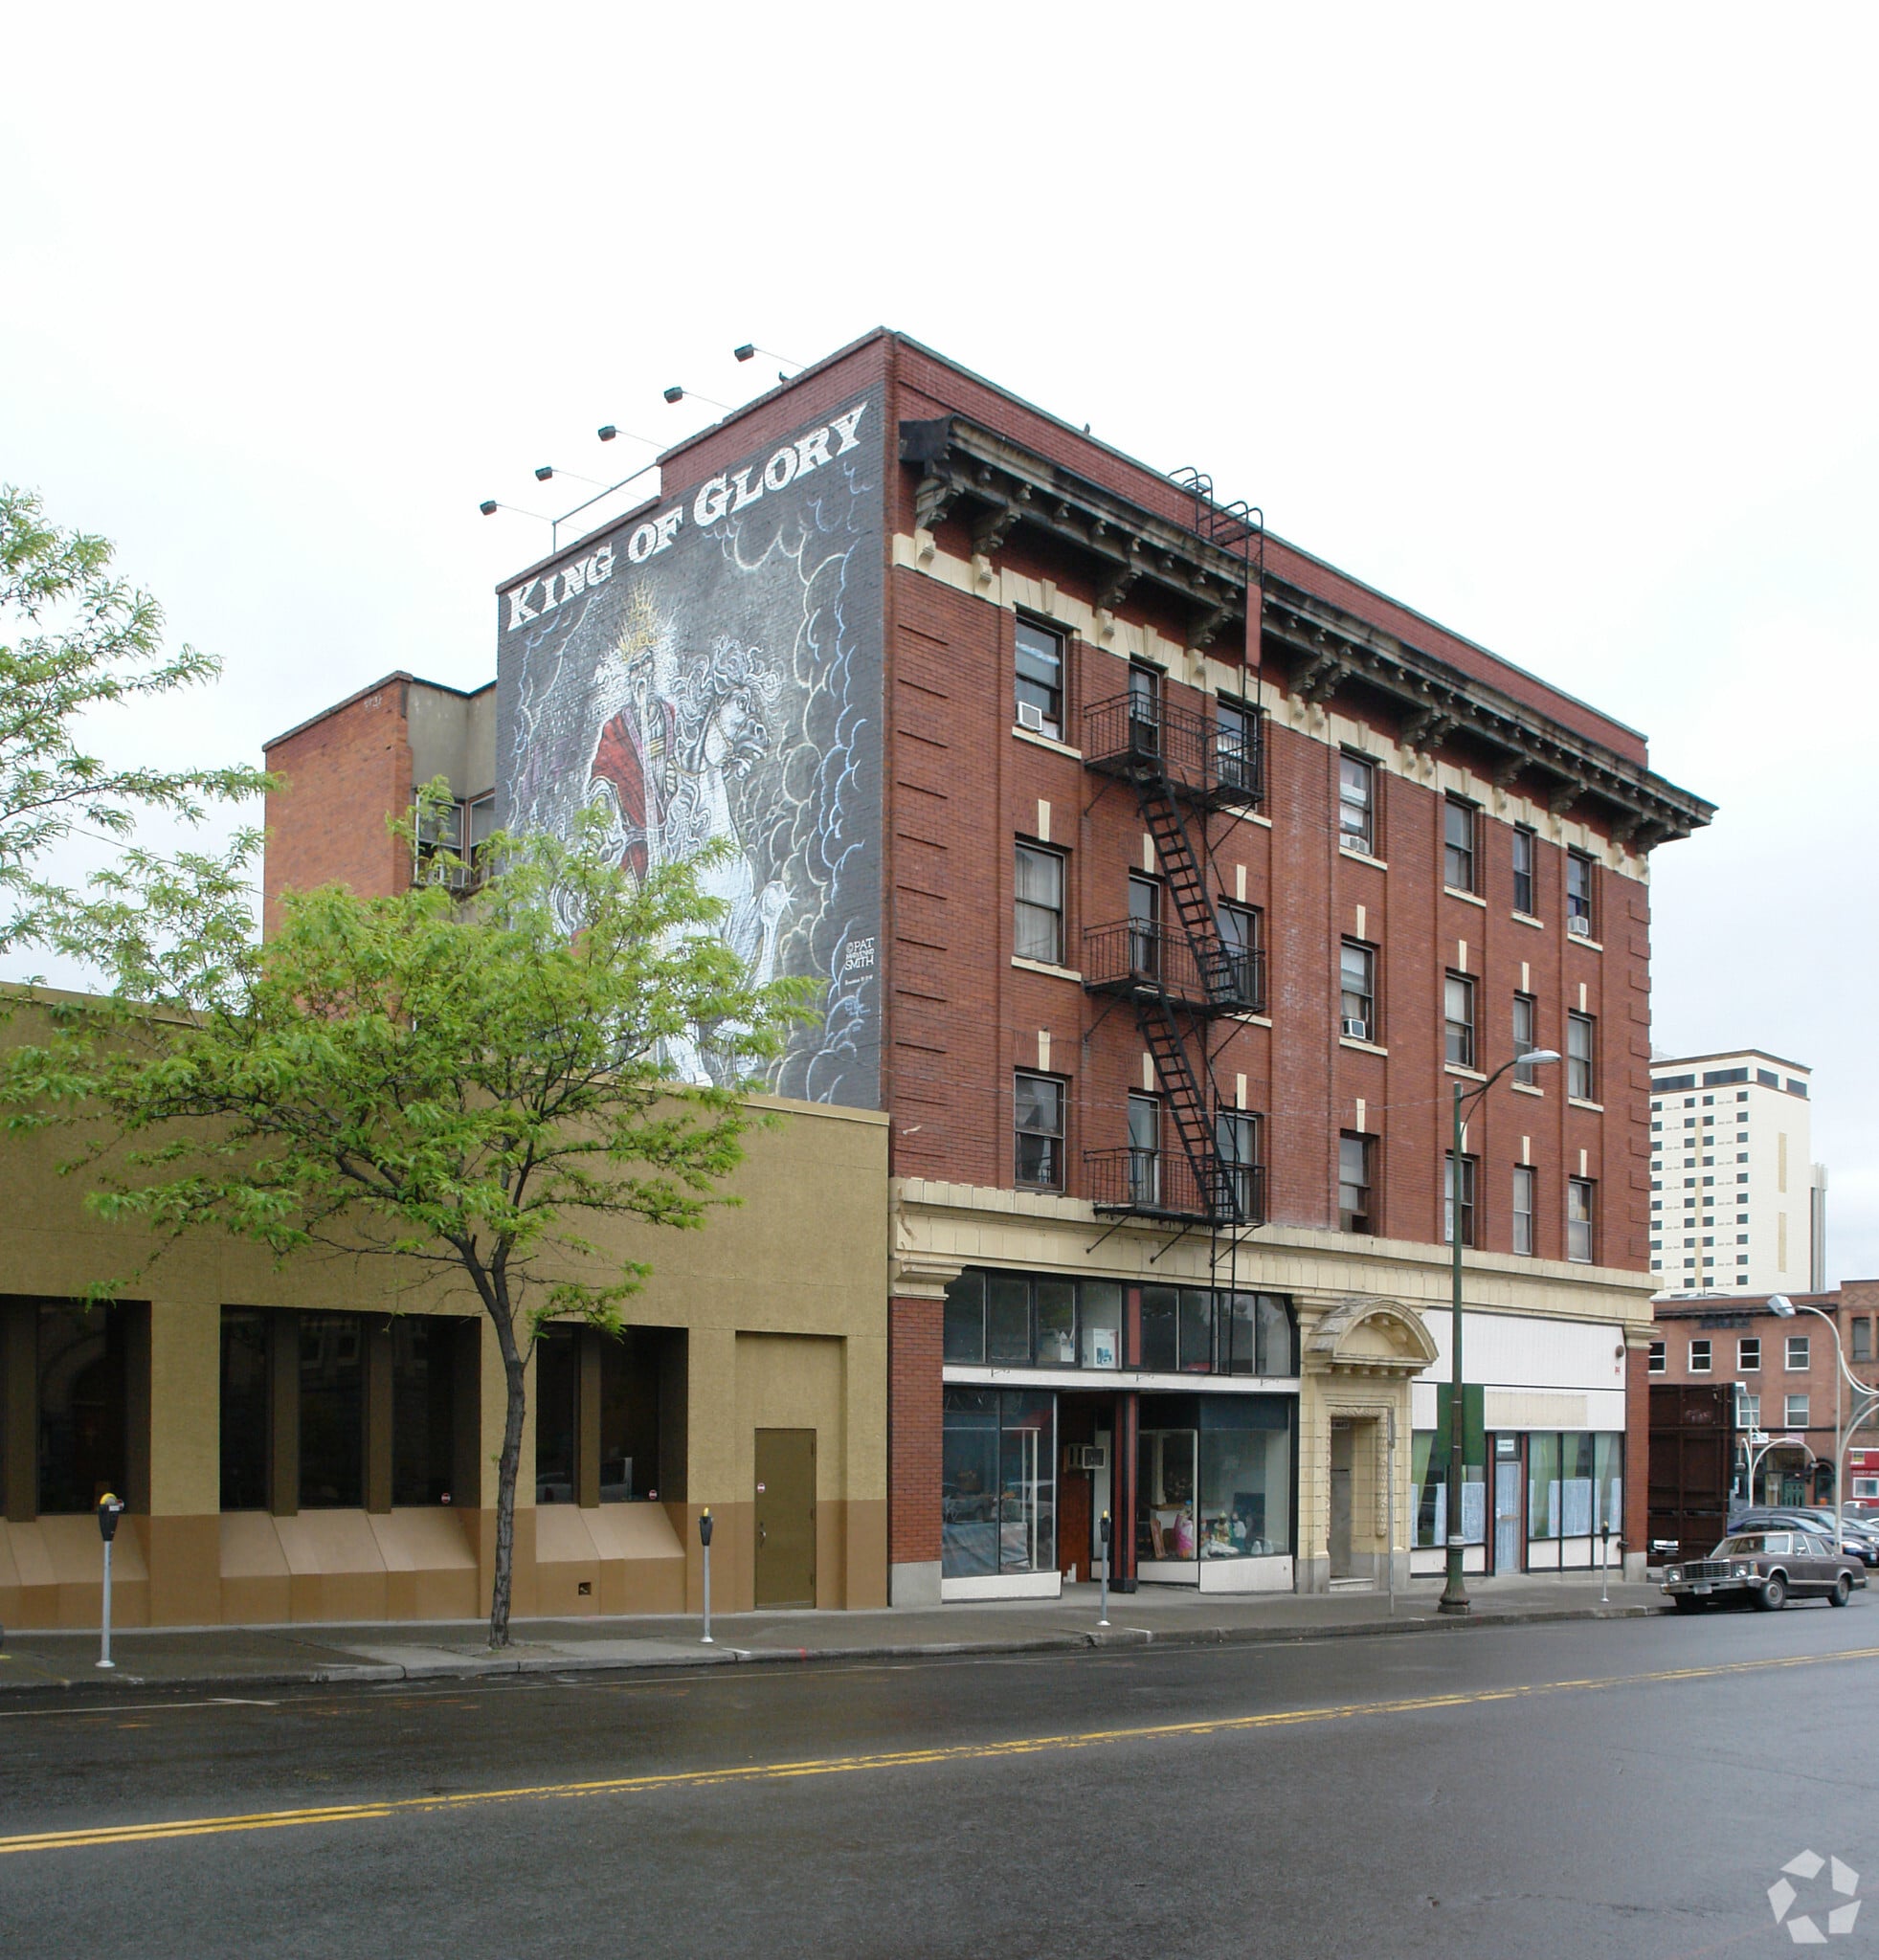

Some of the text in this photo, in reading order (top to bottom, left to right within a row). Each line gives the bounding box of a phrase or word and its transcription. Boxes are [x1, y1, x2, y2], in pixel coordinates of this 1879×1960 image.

[507, 400, 869, 632] KING OF GLORY
[844, 955, 874, 970] SMITH
